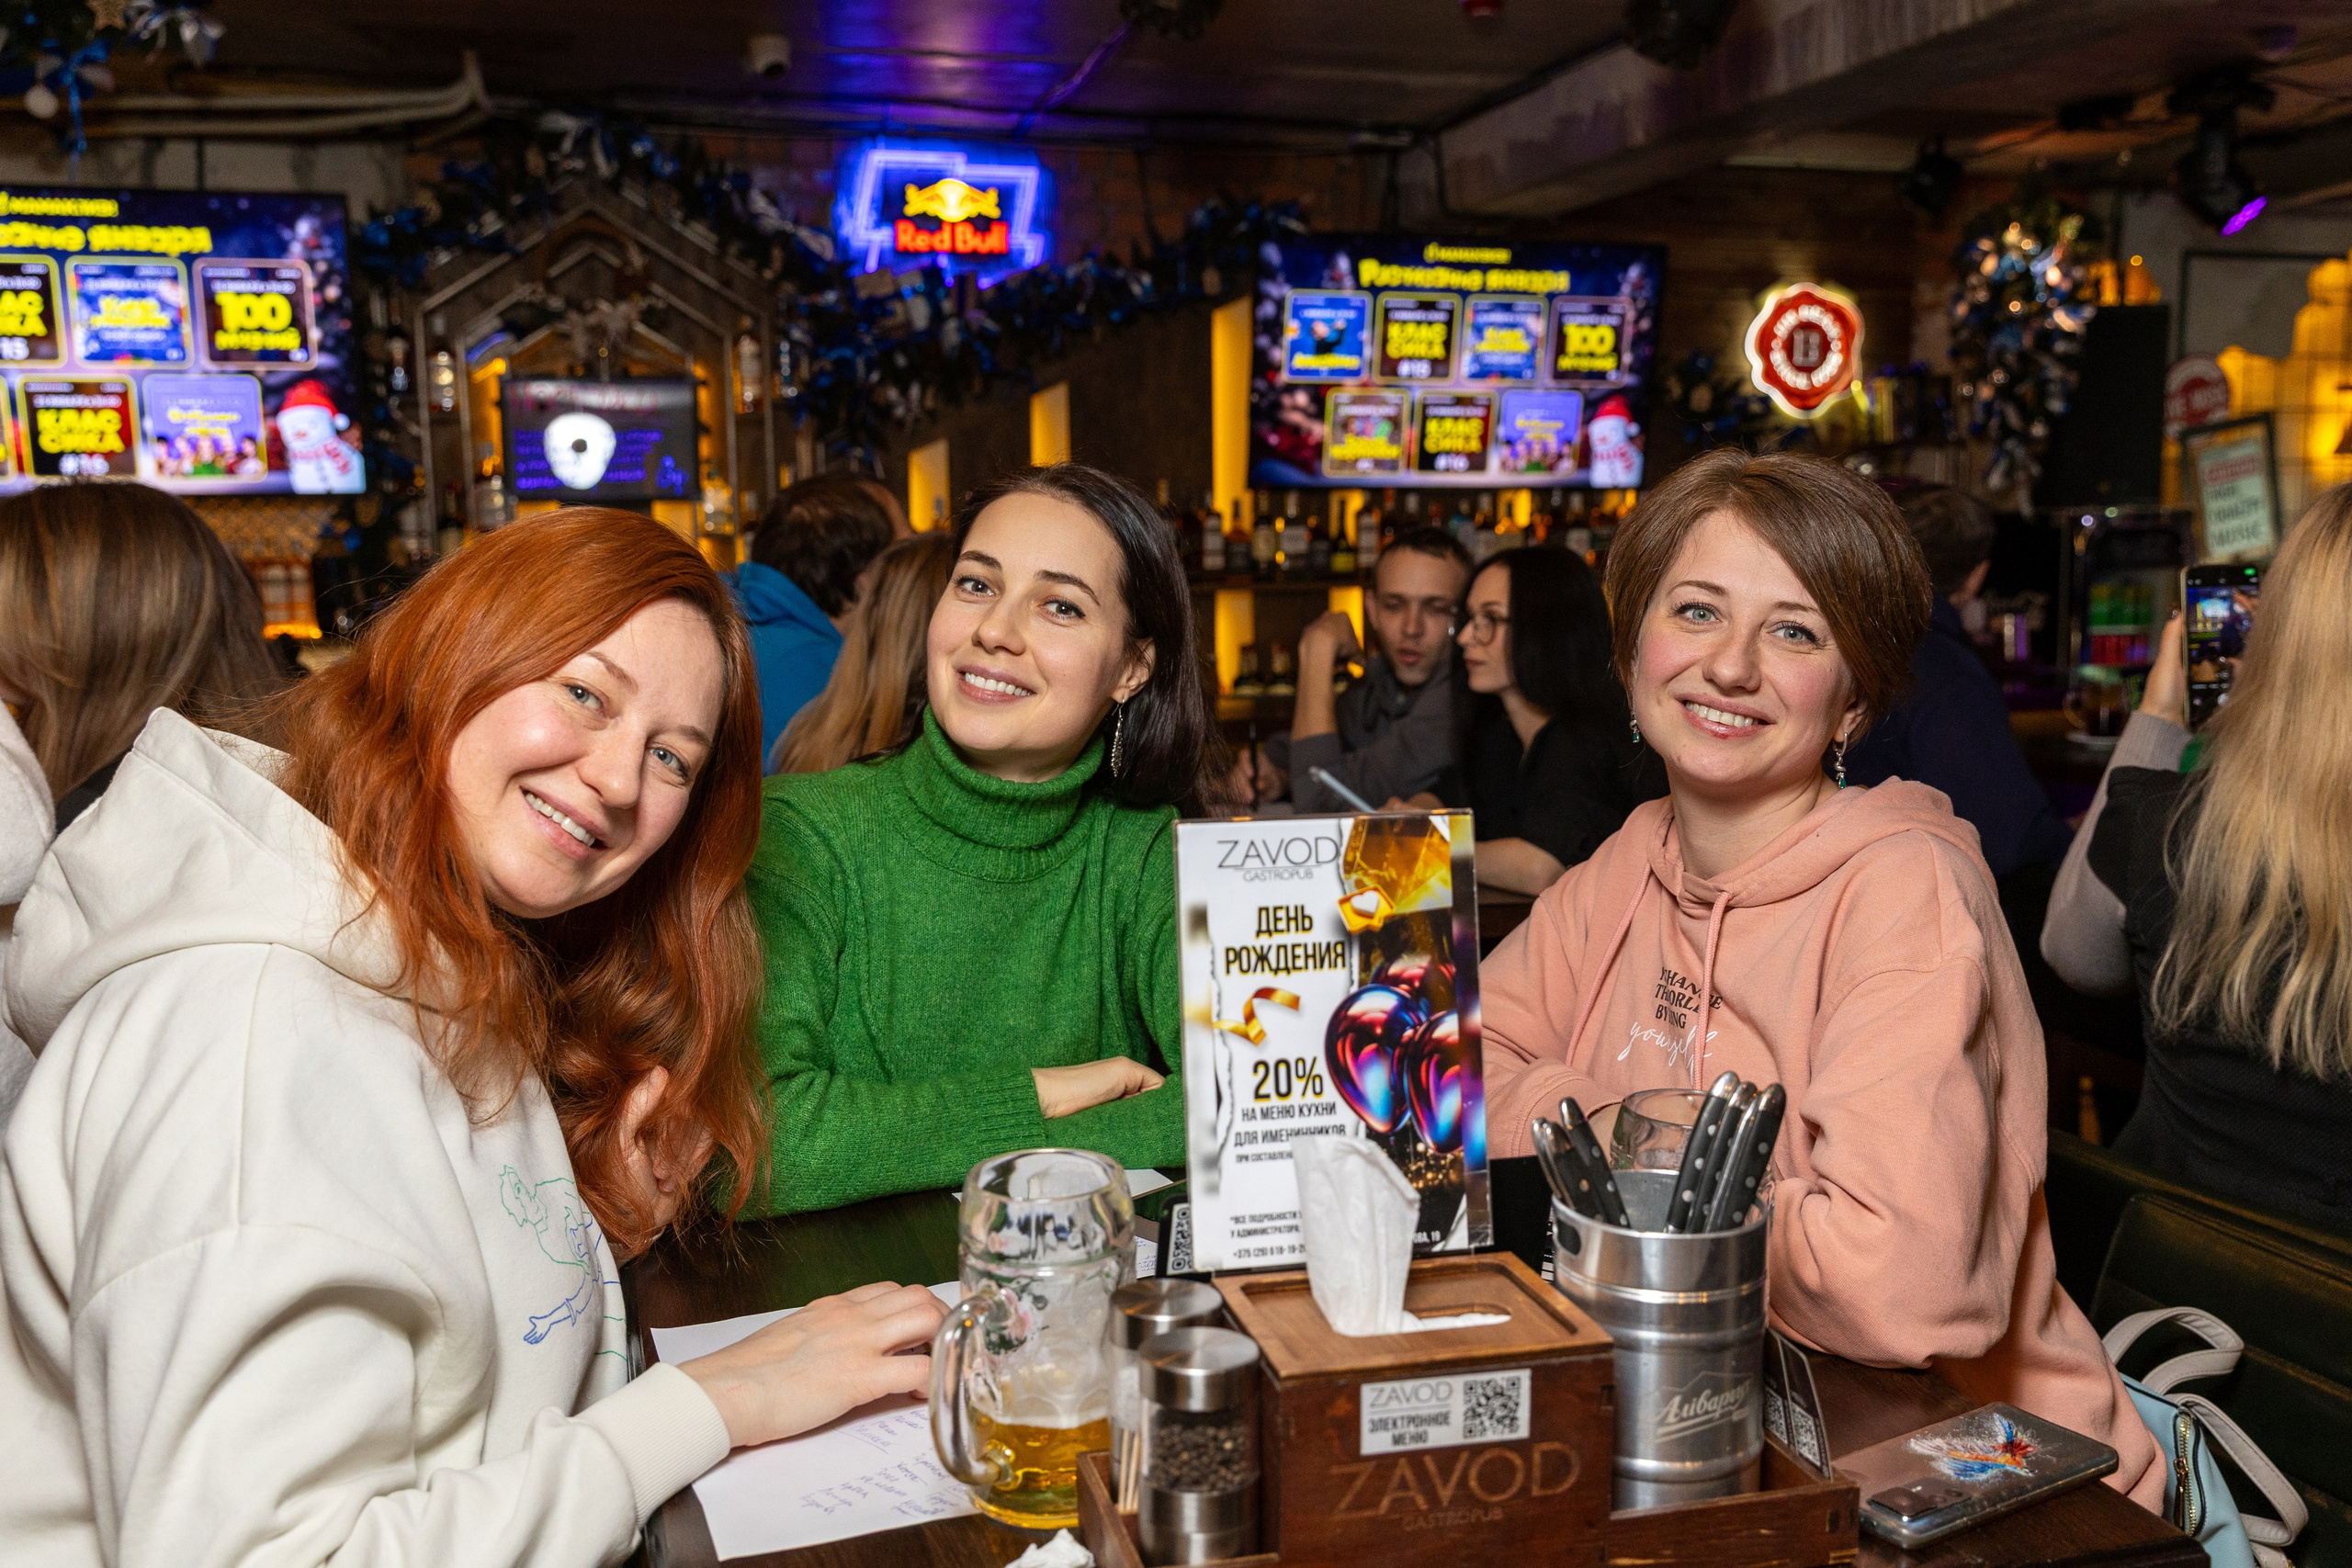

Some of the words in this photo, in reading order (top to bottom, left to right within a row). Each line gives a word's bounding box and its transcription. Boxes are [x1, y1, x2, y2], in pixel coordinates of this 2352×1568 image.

[895, 220, 952, 253] Red
[954, 220, 1009, 254] Bull
[1217, 836, 1340, 868] ZAVOD
[1243, 868, 1314, 882] GASTROPUB
[1255, 904, 1313, 939] ДЕНЬ
[1225, 941, 1347, 976] РОЖДЕНИЯ
[1253, 1055, 1323, 1102] 20%
[1241, 1108, 1258, 1122] НА
[1260, 1104, 1295, 1120] МЕНЮ
[1298, 1101, 1337, 1118] КУХНИ
[1234, 1131, 1258, 1147] ДЛЯ
[1369, 1381, 1453, 1408] ZAVOD
[1368, 1410, 1451, 1433] ЭЛЕКТРОННОЕ
[1392, 1429, 1429, 1446] МЕНЮ
[1330, 1440, 1580, 1519] ZAVOD
